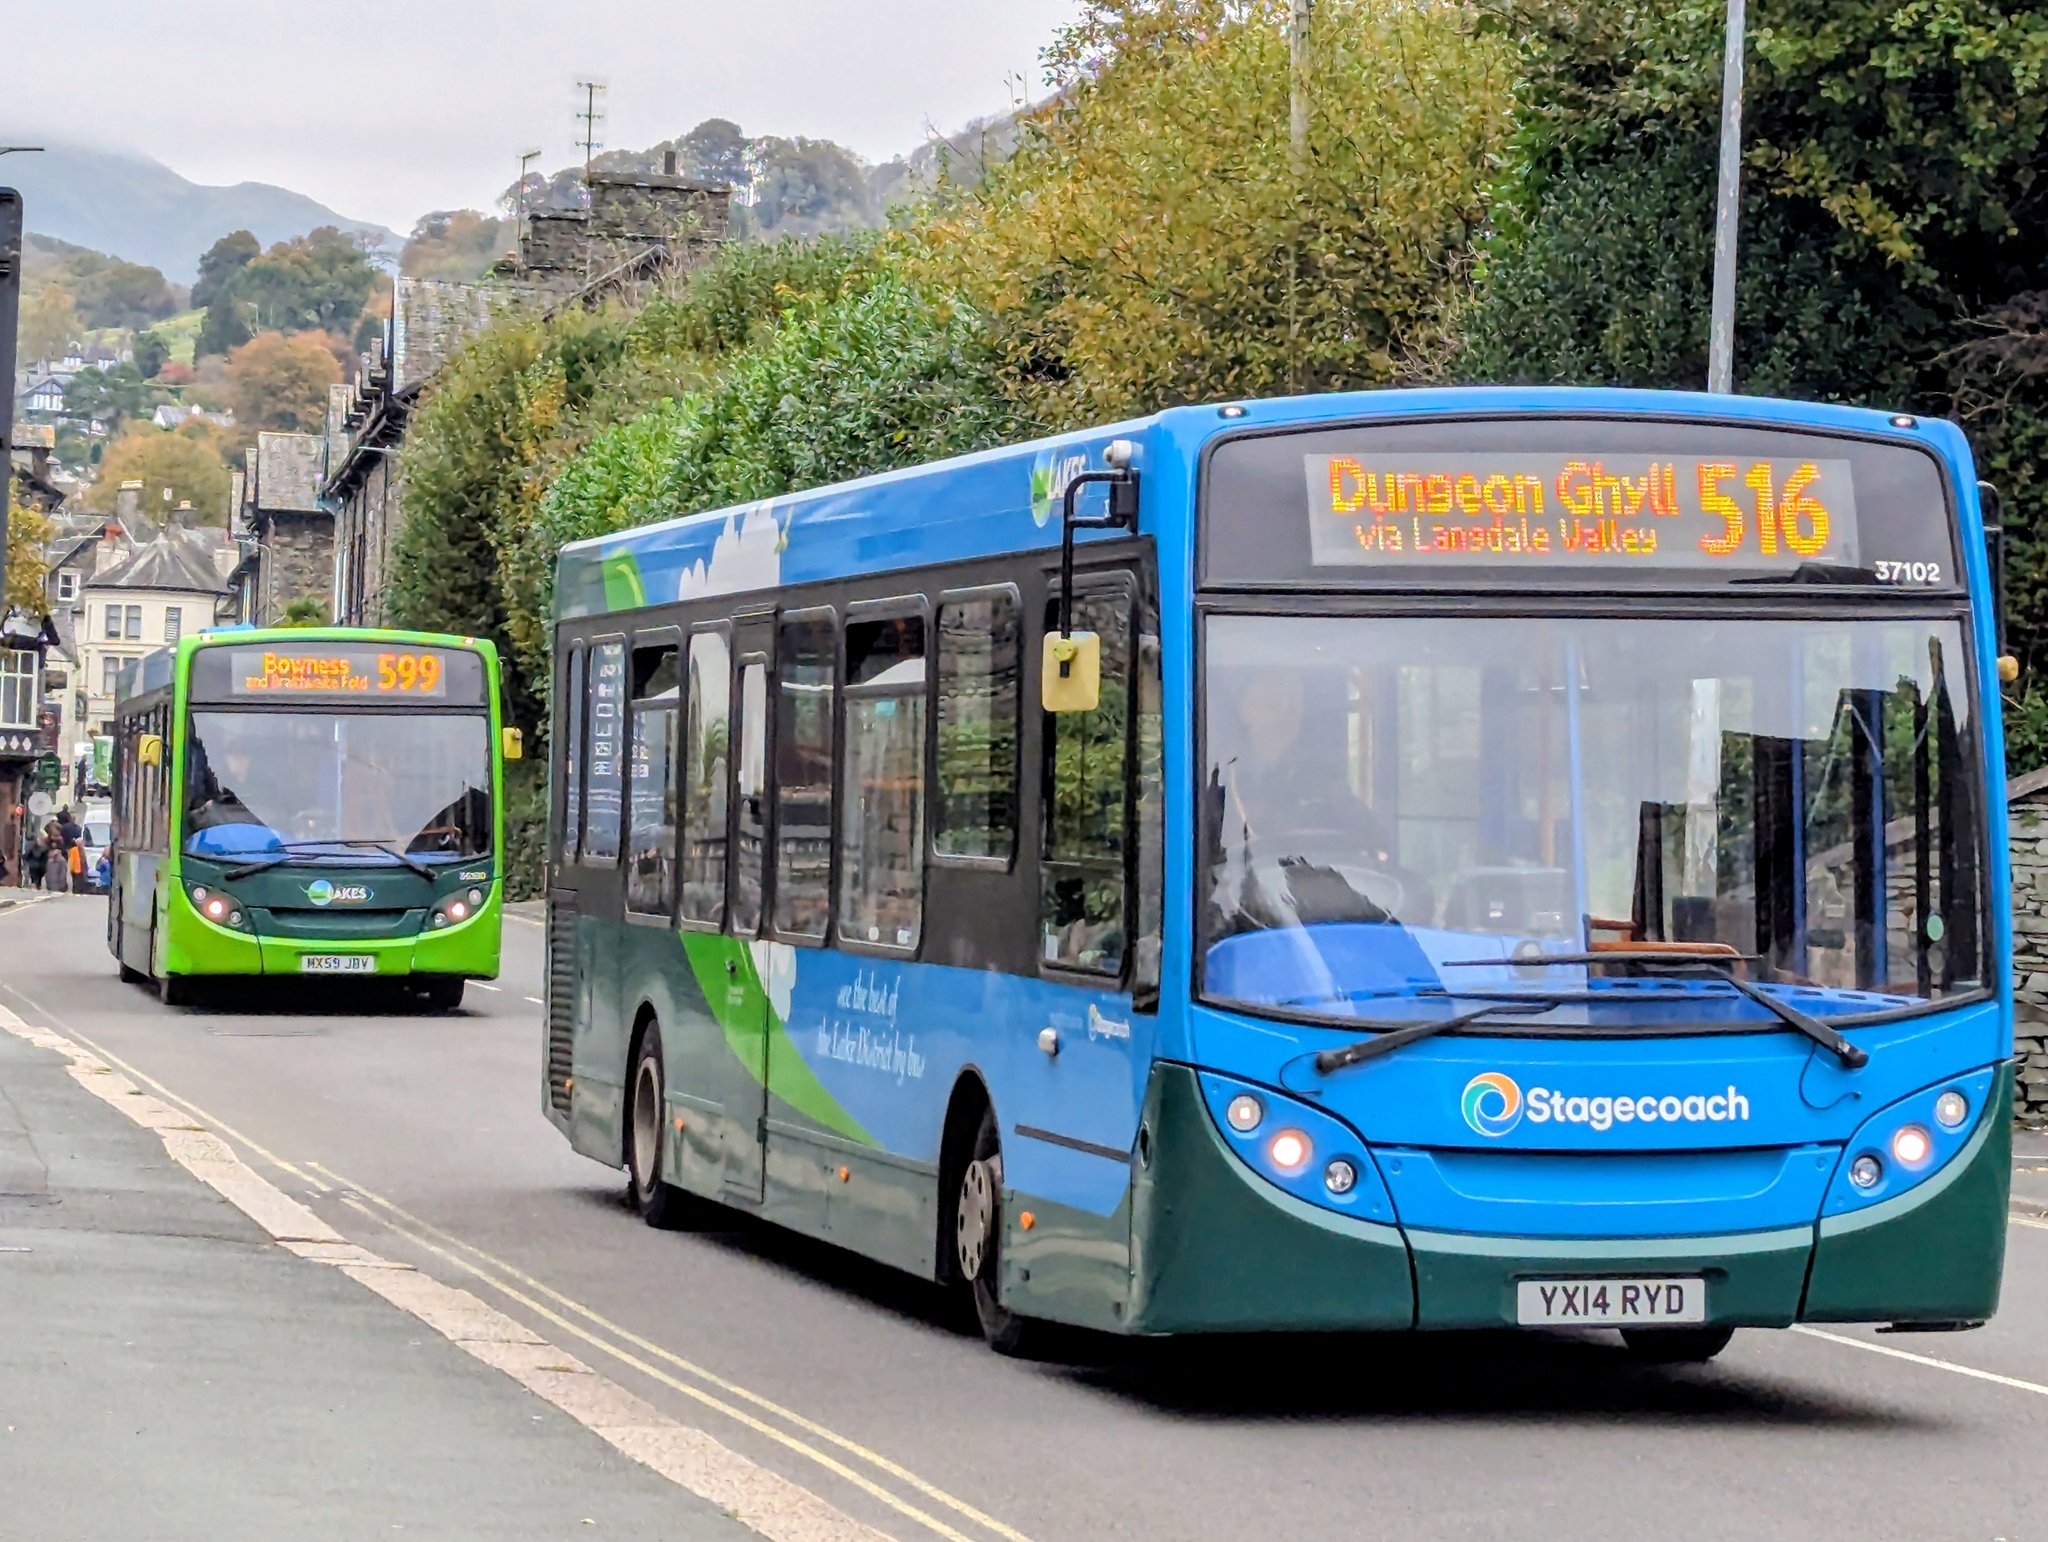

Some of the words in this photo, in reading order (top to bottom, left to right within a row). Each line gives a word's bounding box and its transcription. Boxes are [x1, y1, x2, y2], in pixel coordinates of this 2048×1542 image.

[1329, 457, 1544, 514] Dungeon
[1556, 461, 1680, 516] Ghyll
[1697, 461, 1830, 556] 516
[1355, 518, 1403, 551] via
[1558, 517, 1658, 553] Valley
[1875, 560, 1941, 582] 37102
[262, 651, 351, 676] Bowness
[376, 652, 441, 692] 599
[327, 887, 368, 901] LAKES
[1526, 1084, 1750, 1131] Stagecoach
[1539, 1284, 1611, 1316] YX14
[1621, 1284, 1684, 1316] RYD
